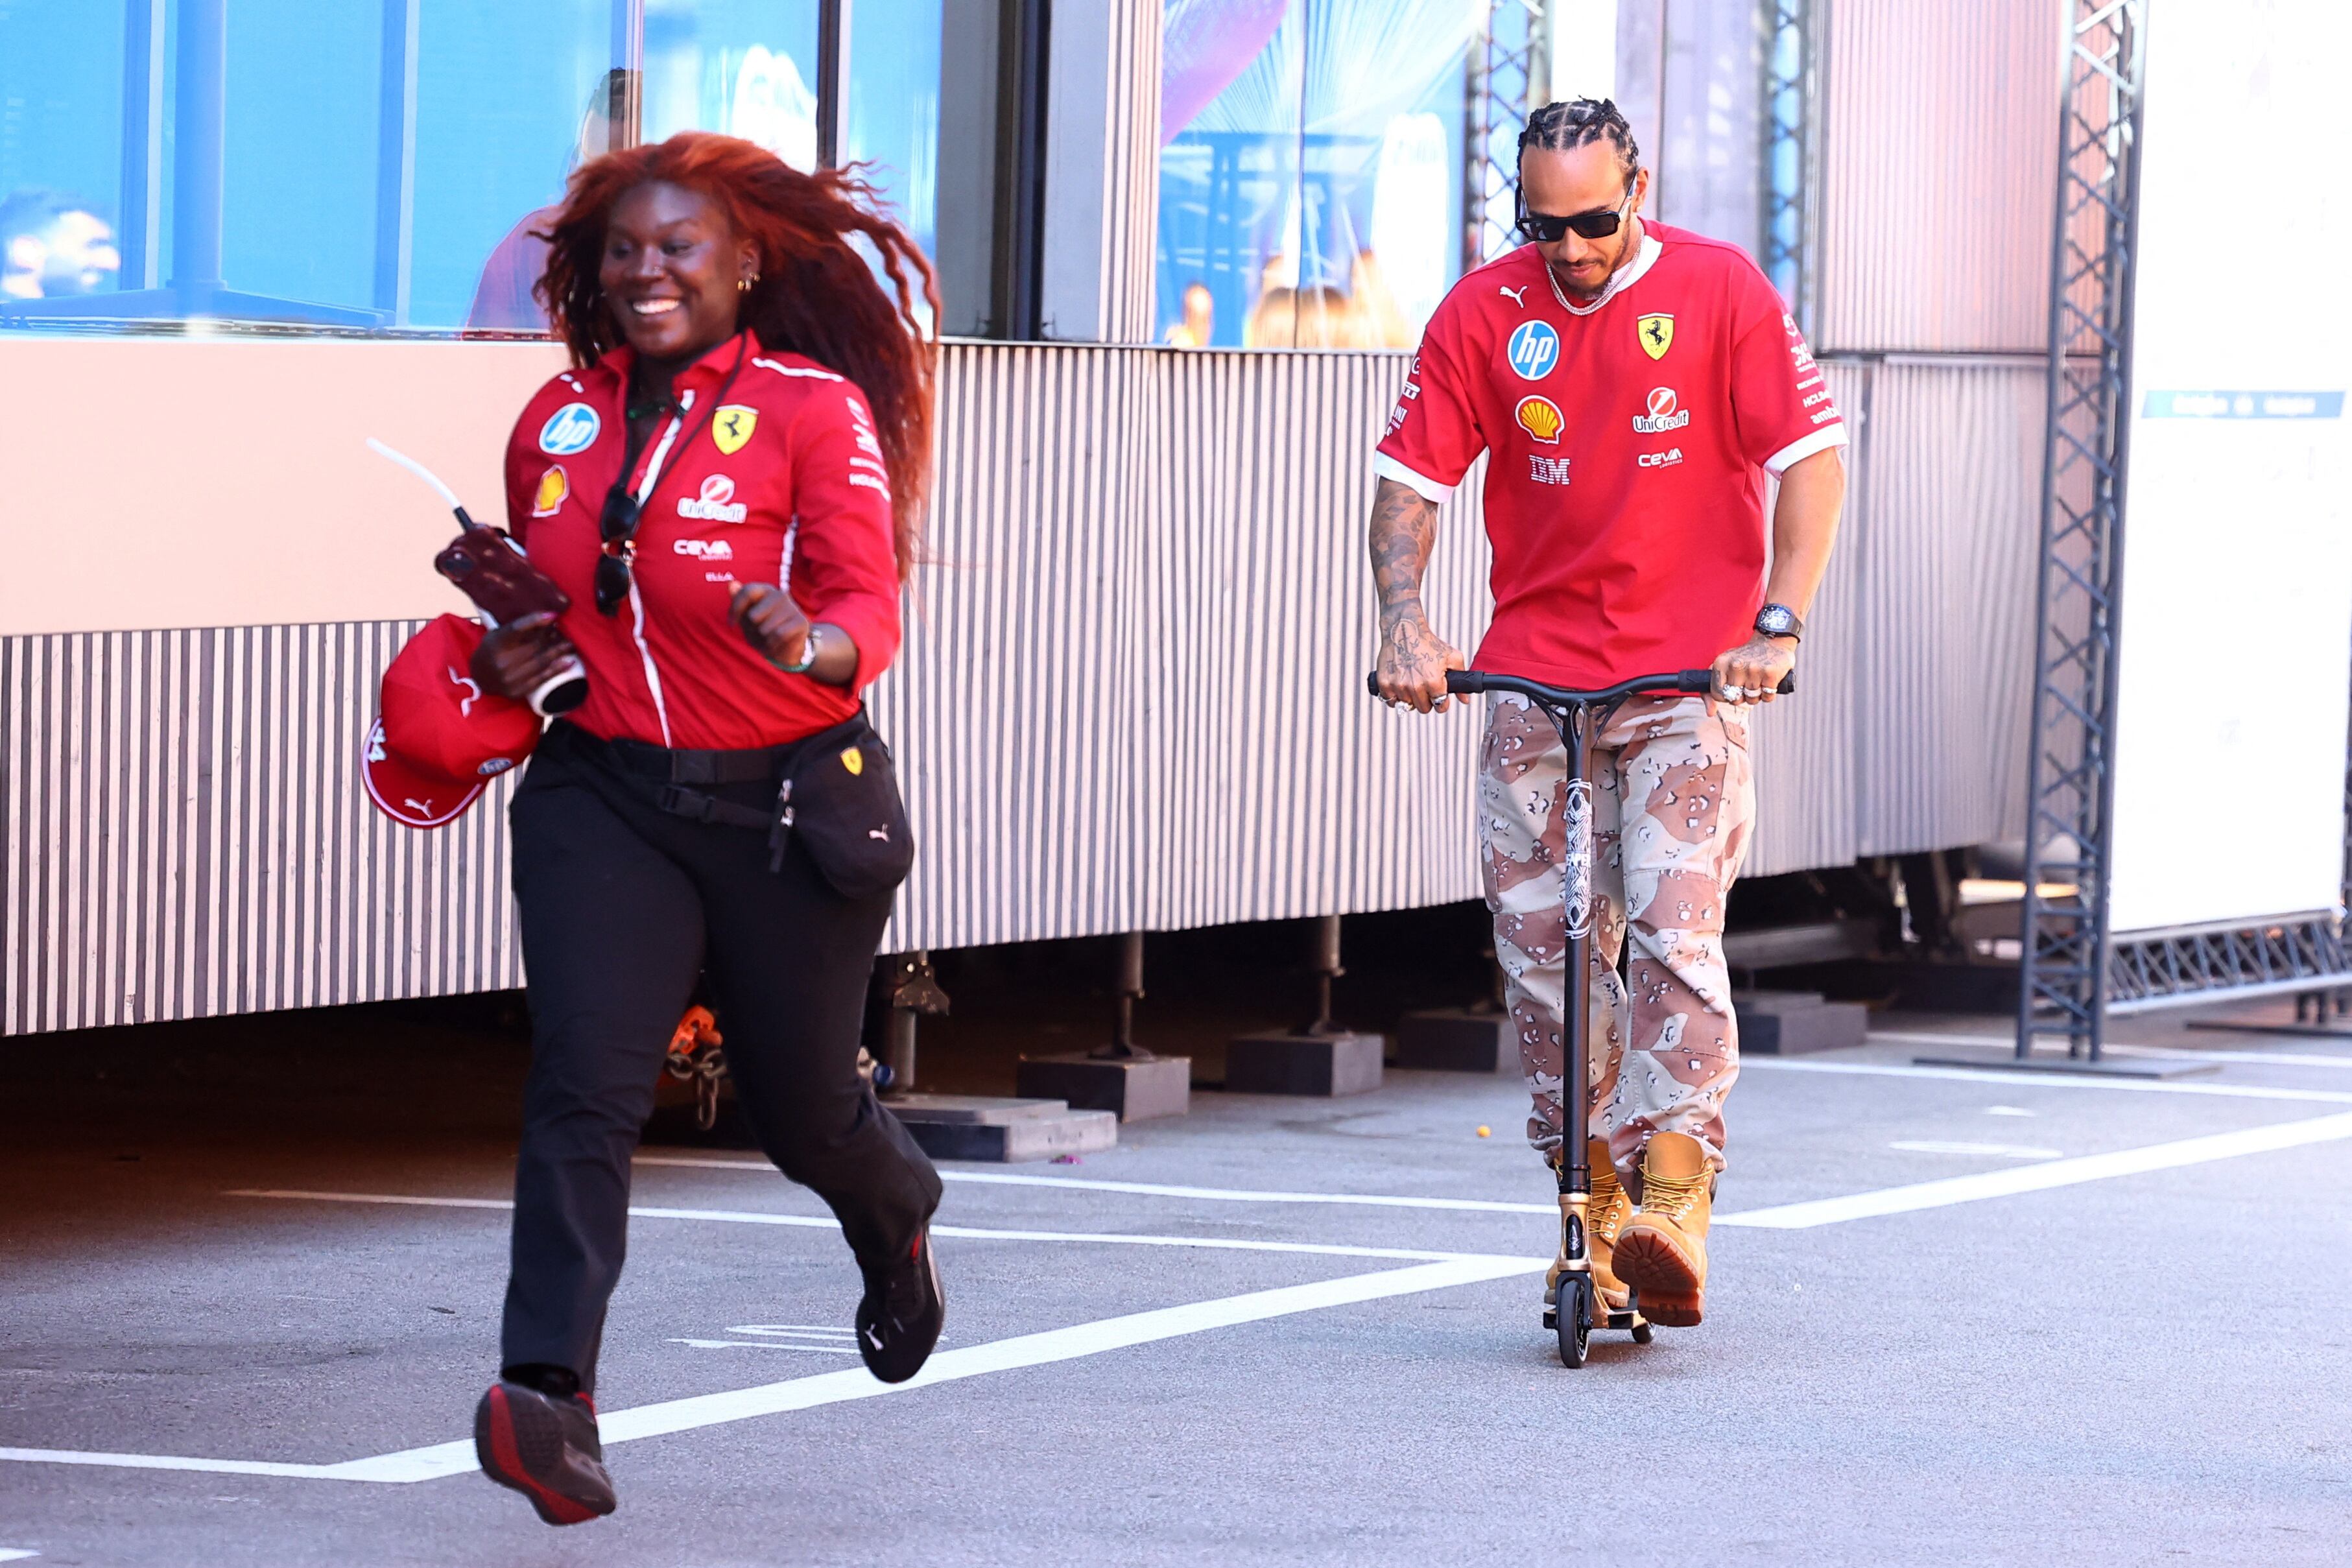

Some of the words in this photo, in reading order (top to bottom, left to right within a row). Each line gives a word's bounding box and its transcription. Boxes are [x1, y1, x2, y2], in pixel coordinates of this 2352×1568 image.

[1513, 320, 1556, 380] hp
[1634, 411, 1688, 431] UniCredit
[1529, 455, 1570, 485] IBM
[679, 498, 746, 522] UniCredit
